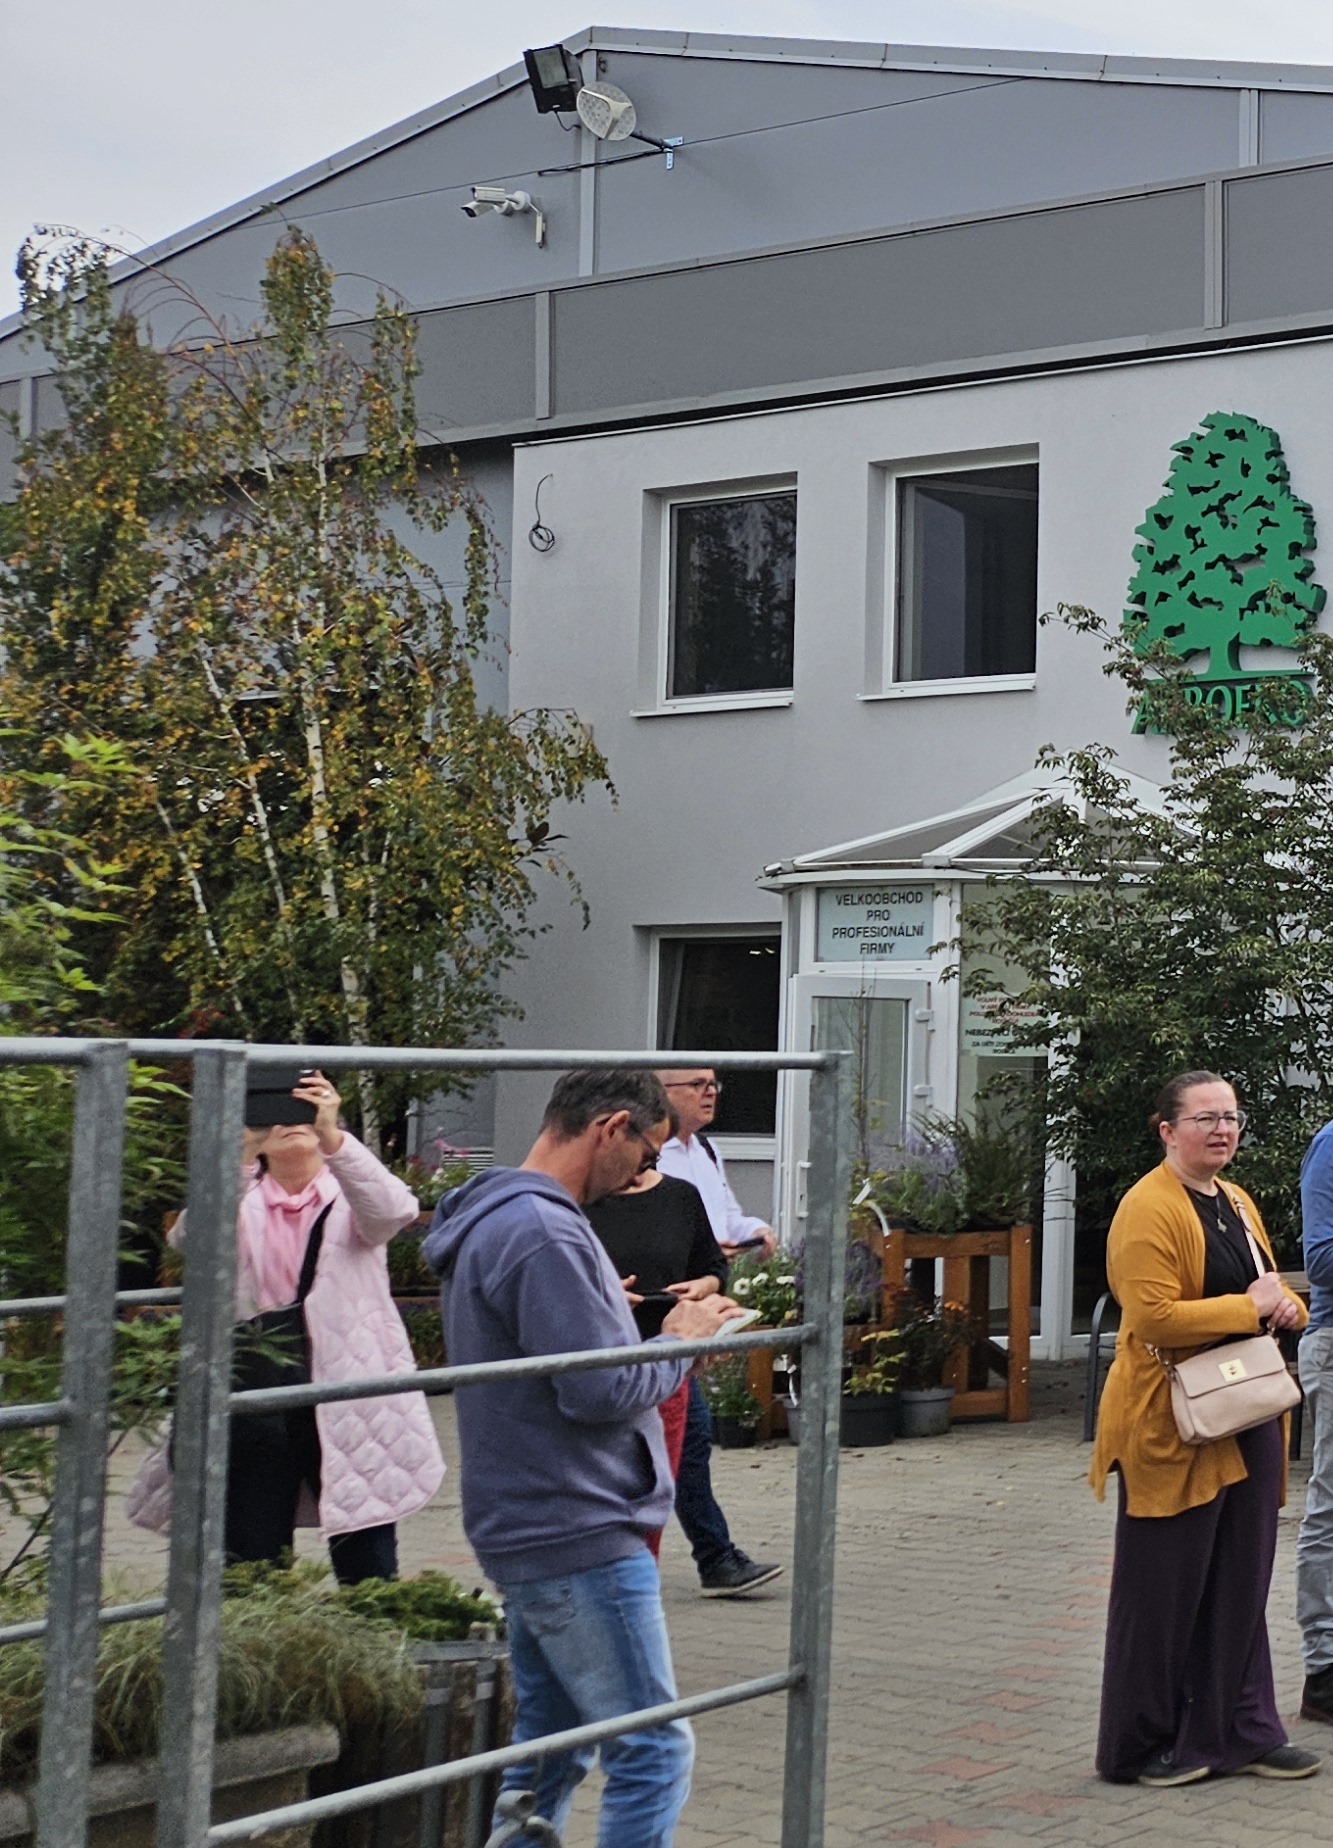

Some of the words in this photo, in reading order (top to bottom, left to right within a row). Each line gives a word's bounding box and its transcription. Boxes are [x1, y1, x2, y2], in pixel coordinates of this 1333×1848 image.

[835, 891, 924, 906] VELKOOBCHOD
[866, 910, 890, 921] PRO
[832, 922, 924, 938] PROFESIONÁLNÍ
[860, 943, 895, 954] FIRMY
